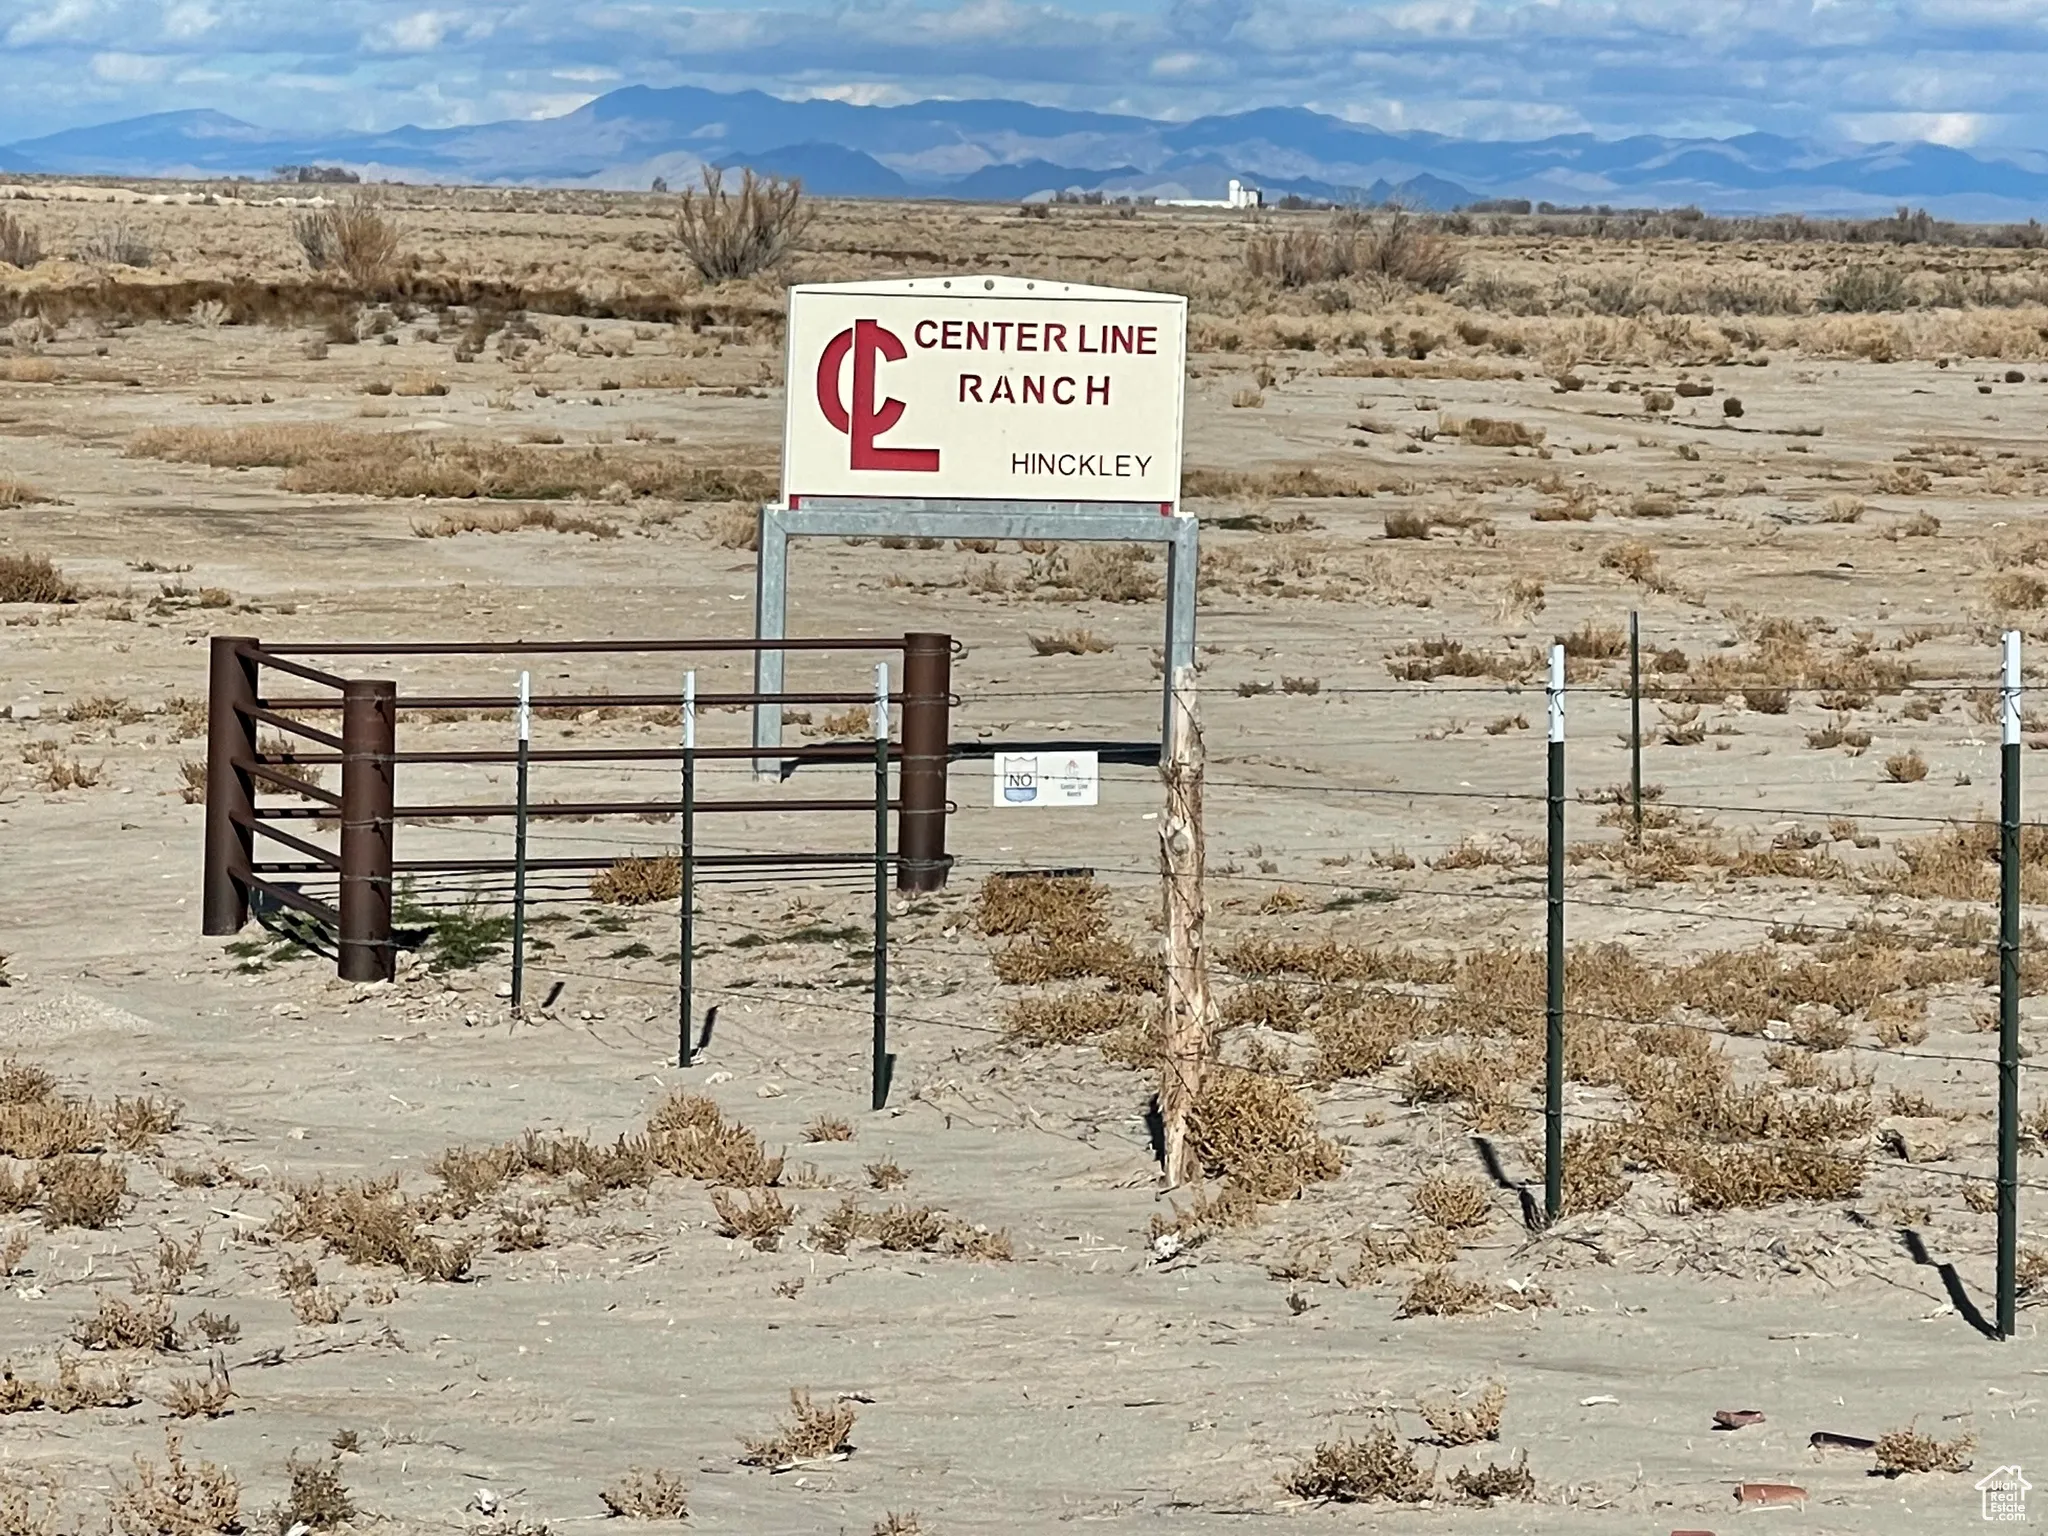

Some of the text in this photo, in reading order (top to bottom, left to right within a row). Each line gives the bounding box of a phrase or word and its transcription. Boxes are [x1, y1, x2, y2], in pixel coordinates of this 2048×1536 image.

[914, 320, 1158, 354] CENTER LINE
[959, 374, 1111, 405] RANCH
[1012, 453, 1153, 477] HINCKLEY
[1009, 774, 1032, 786] NO
